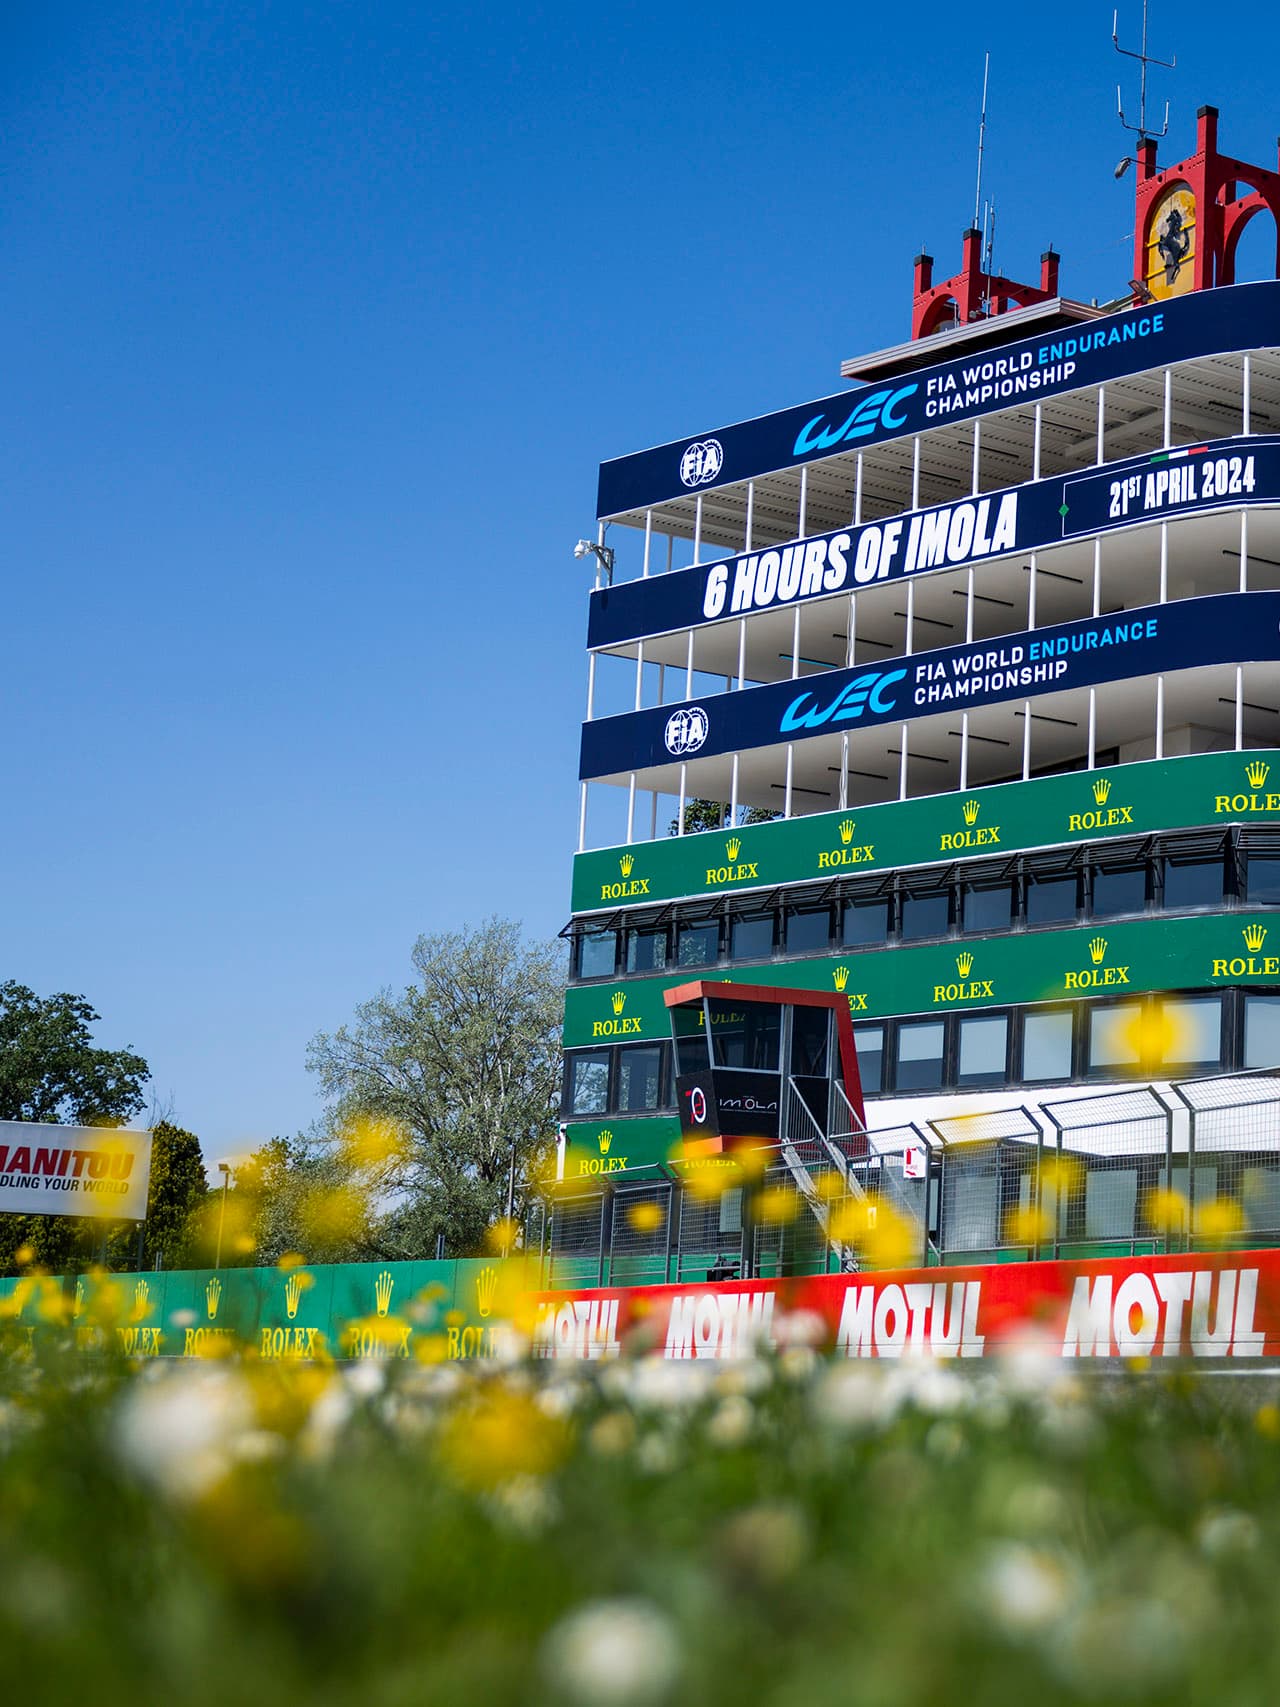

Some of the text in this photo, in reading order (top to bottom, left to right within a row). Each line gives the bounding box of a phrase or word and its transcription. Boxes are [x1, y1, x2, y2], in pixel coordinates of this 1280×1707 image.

[926, 314, 1165, 397] FIA WORLD ENDURANCE
[925, 361, 1076, 418] CHAMPIONSHIP
[792, 383, 919, 456] WEC
[1143, 464, 1197, 510] APRIL
[1201, 455, 1256, 498] 2024
[702, 492, 1018, 619] 6 HOURS OF IMOLA
[915, 619, 1158, 684] FIA WORLD ENDURANCE
[779, 668, 908, 732] WEC
[914, 660, 1068, 705] CHAMPIONSHIP
[1068, 806, 1134, 832] ROLEX
[818, 845, 875, 868] ROLEX
[940, 826, 1001, 851] ROLEX
[601, 878, 650, 899] ROLEX
[706, 862, 759, 885] ROLEX
[933, 980, 994, 1002] ROLEX
[1064, 966, 1129, 989] ROLEX
[592, 1017, 642, 1037] ROLEX
[579, 1157, 628, 1175] ROLEX
[44, 1178, 80, 1191] YOUR
[83, 1180, 129, 1194] WORLD
[664, 1291, 777, 1358] MOTUL
[837, 1281, 986, 1358] MOTUL
[1061, 1268, 1266, 1356] MOTUL
[261, 1327, 318, 1358] ROLEX
